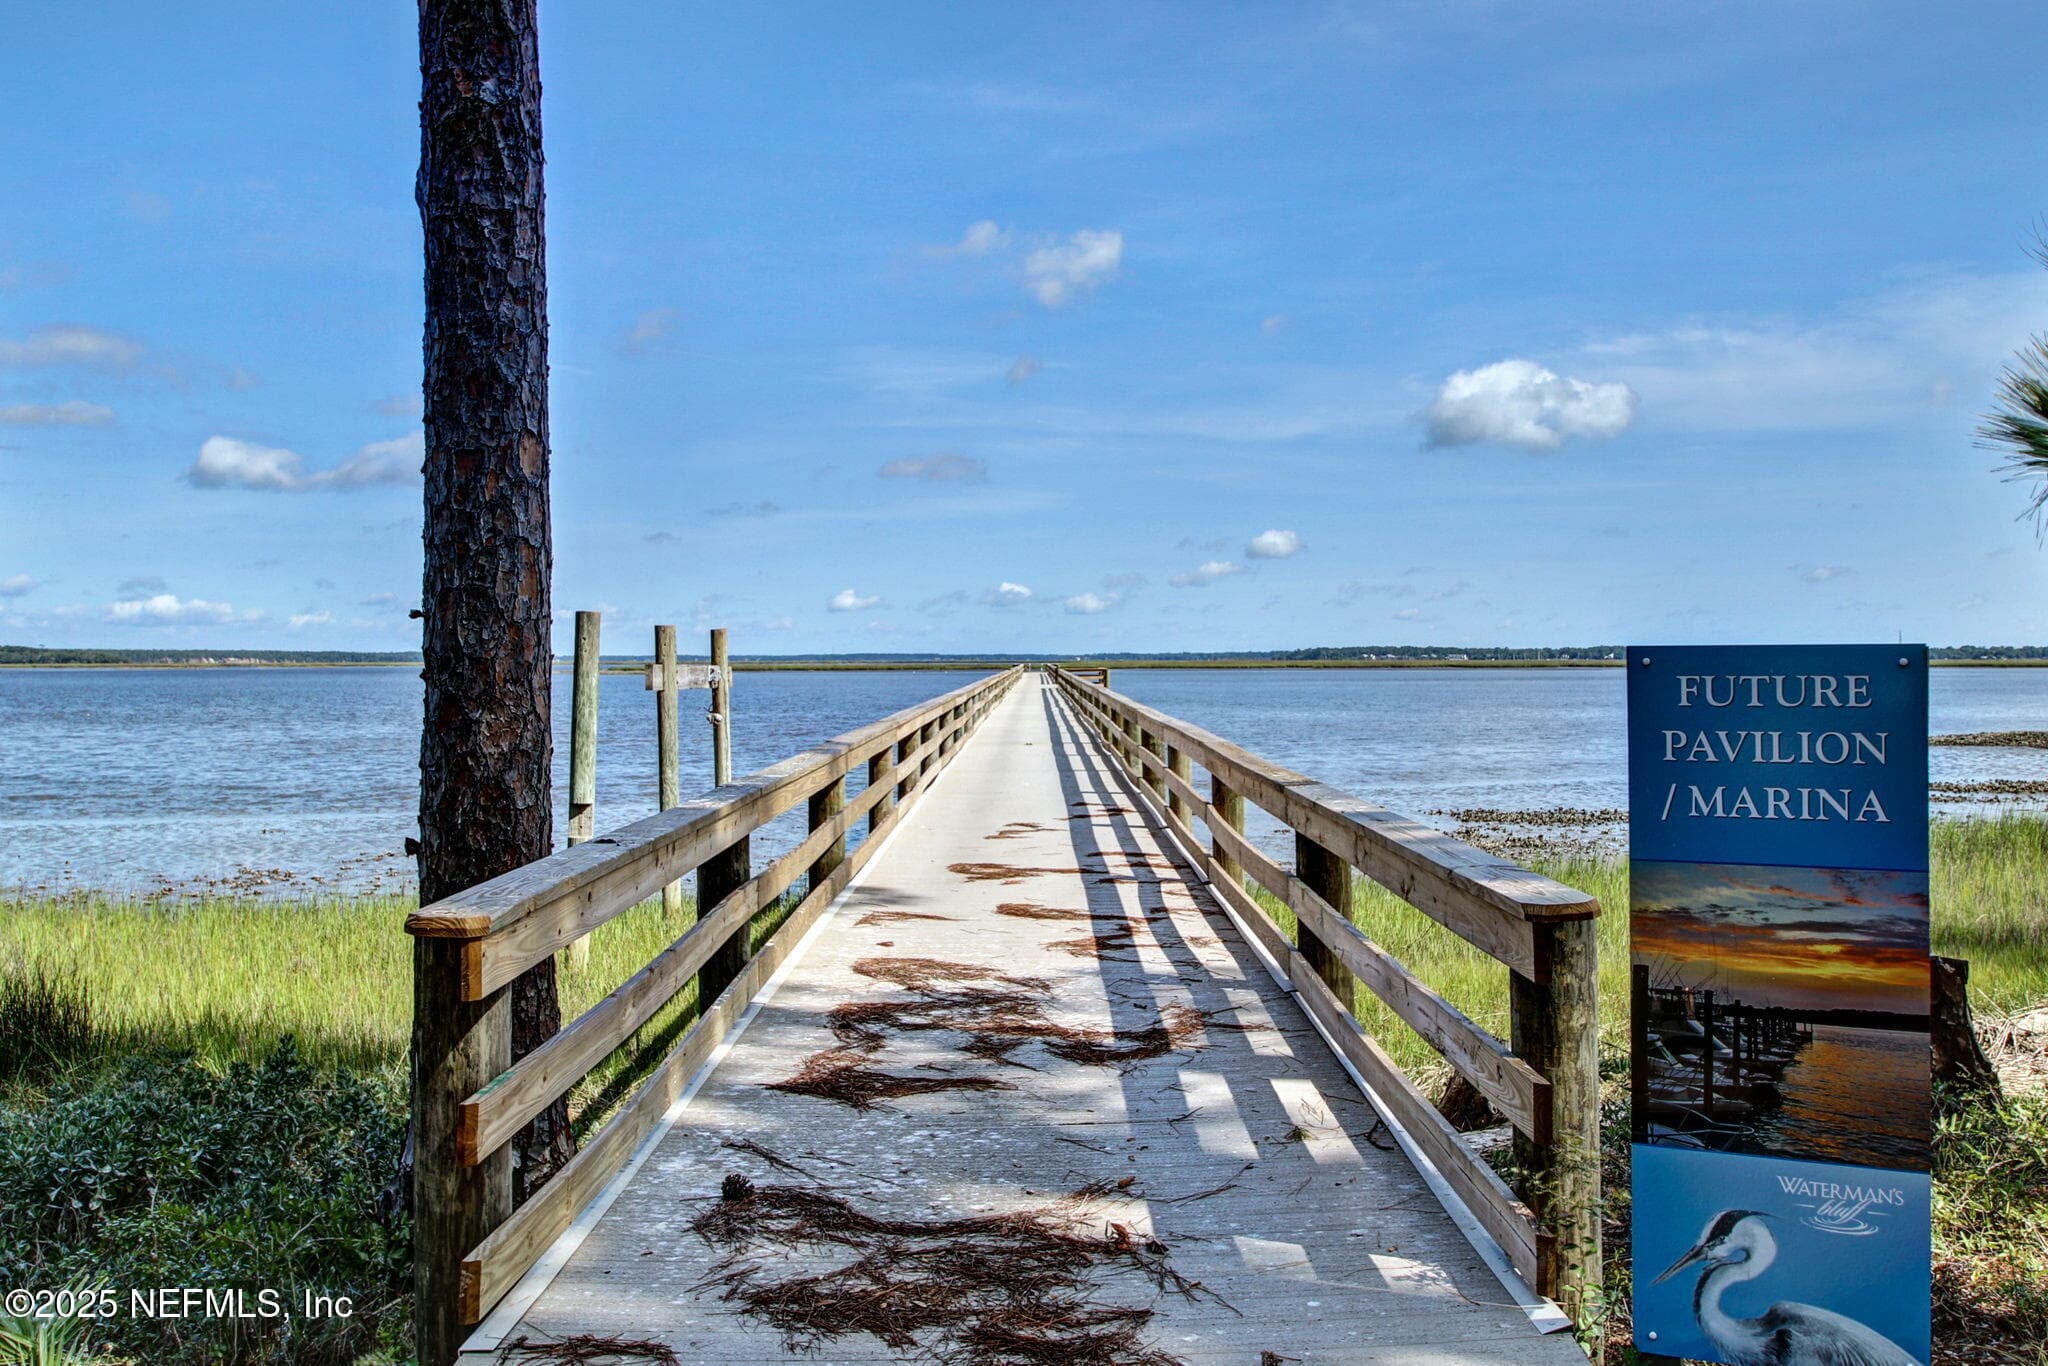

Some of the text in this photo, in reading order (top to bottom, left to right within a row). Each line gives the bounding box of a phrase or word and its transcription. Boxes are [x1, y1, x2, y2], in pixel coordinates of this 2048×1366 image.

[1676, 674, 1873, 708] FUTURE
[1661, 730, 1889, 765] PAVILION
[1688, 785, 1891, 822] MARINA
[1776, 1175, 1905, 1206] WATERMAN'S
[1816, 1199, 1872, 1224] bluff
